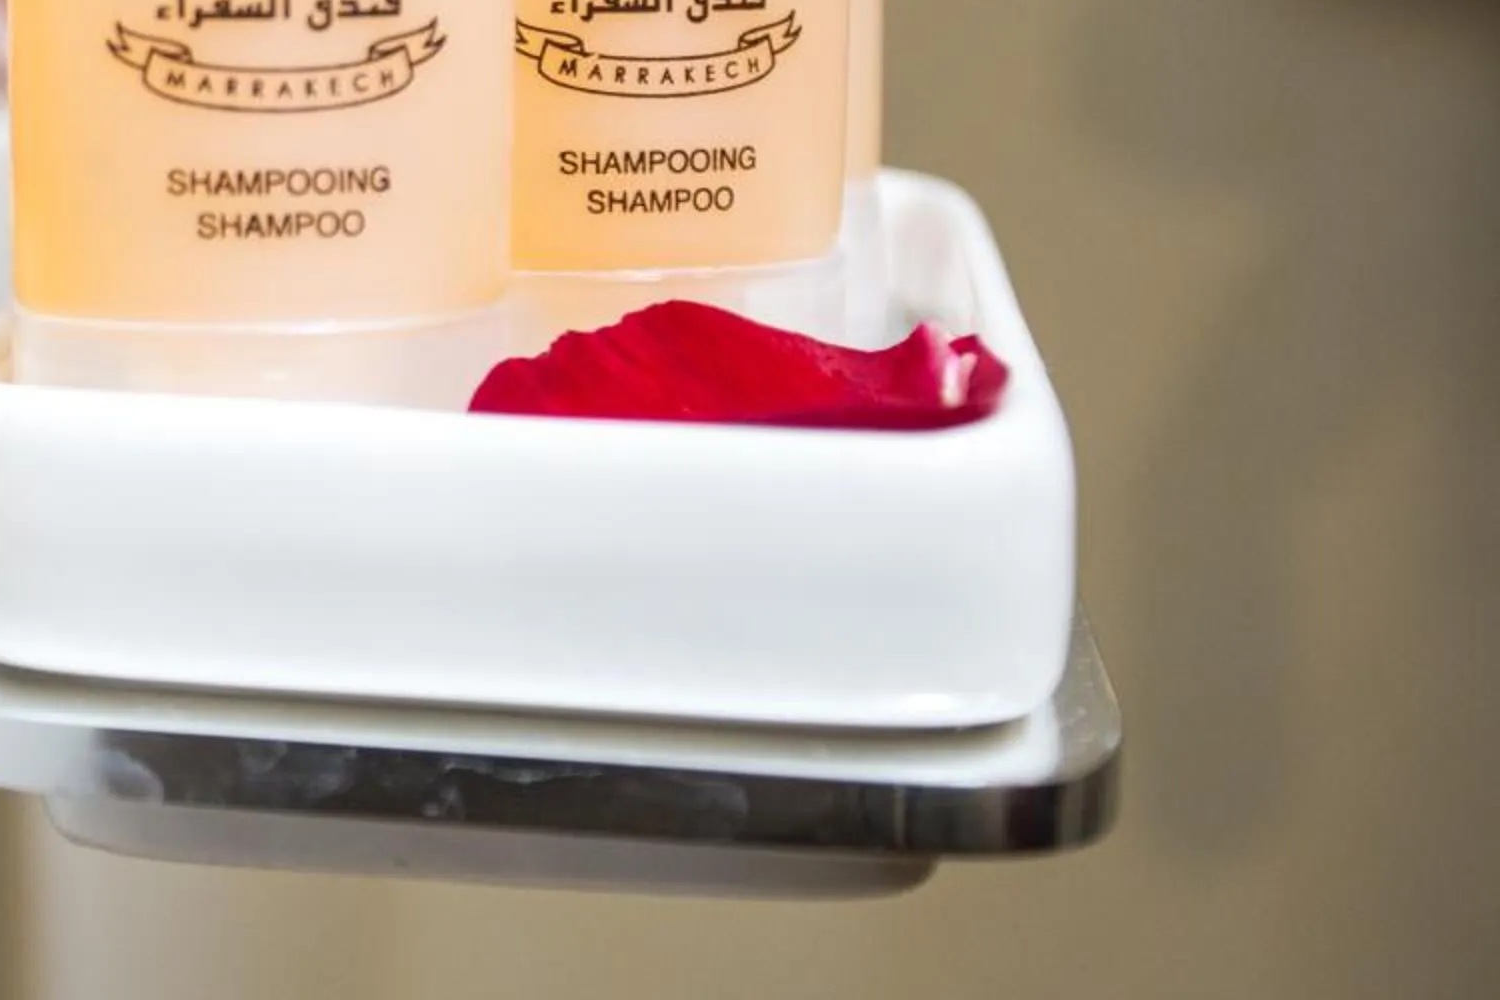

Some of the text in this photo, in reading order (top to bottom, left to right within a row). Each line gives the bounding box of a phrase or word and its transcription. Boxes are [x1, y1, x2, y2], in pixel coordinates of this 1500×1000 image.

[165, 71, 396, 99] MARRAKECH
[559, 57, 760, 85] MARRAKECH
[559, 146, 756, 176] SHAMPOOING
[167, 166, 391, 197] SHAMPOOING
[587, 187, 734, 214] SHAMPOO
[196, 210, 365, 239] SHAMPOO
